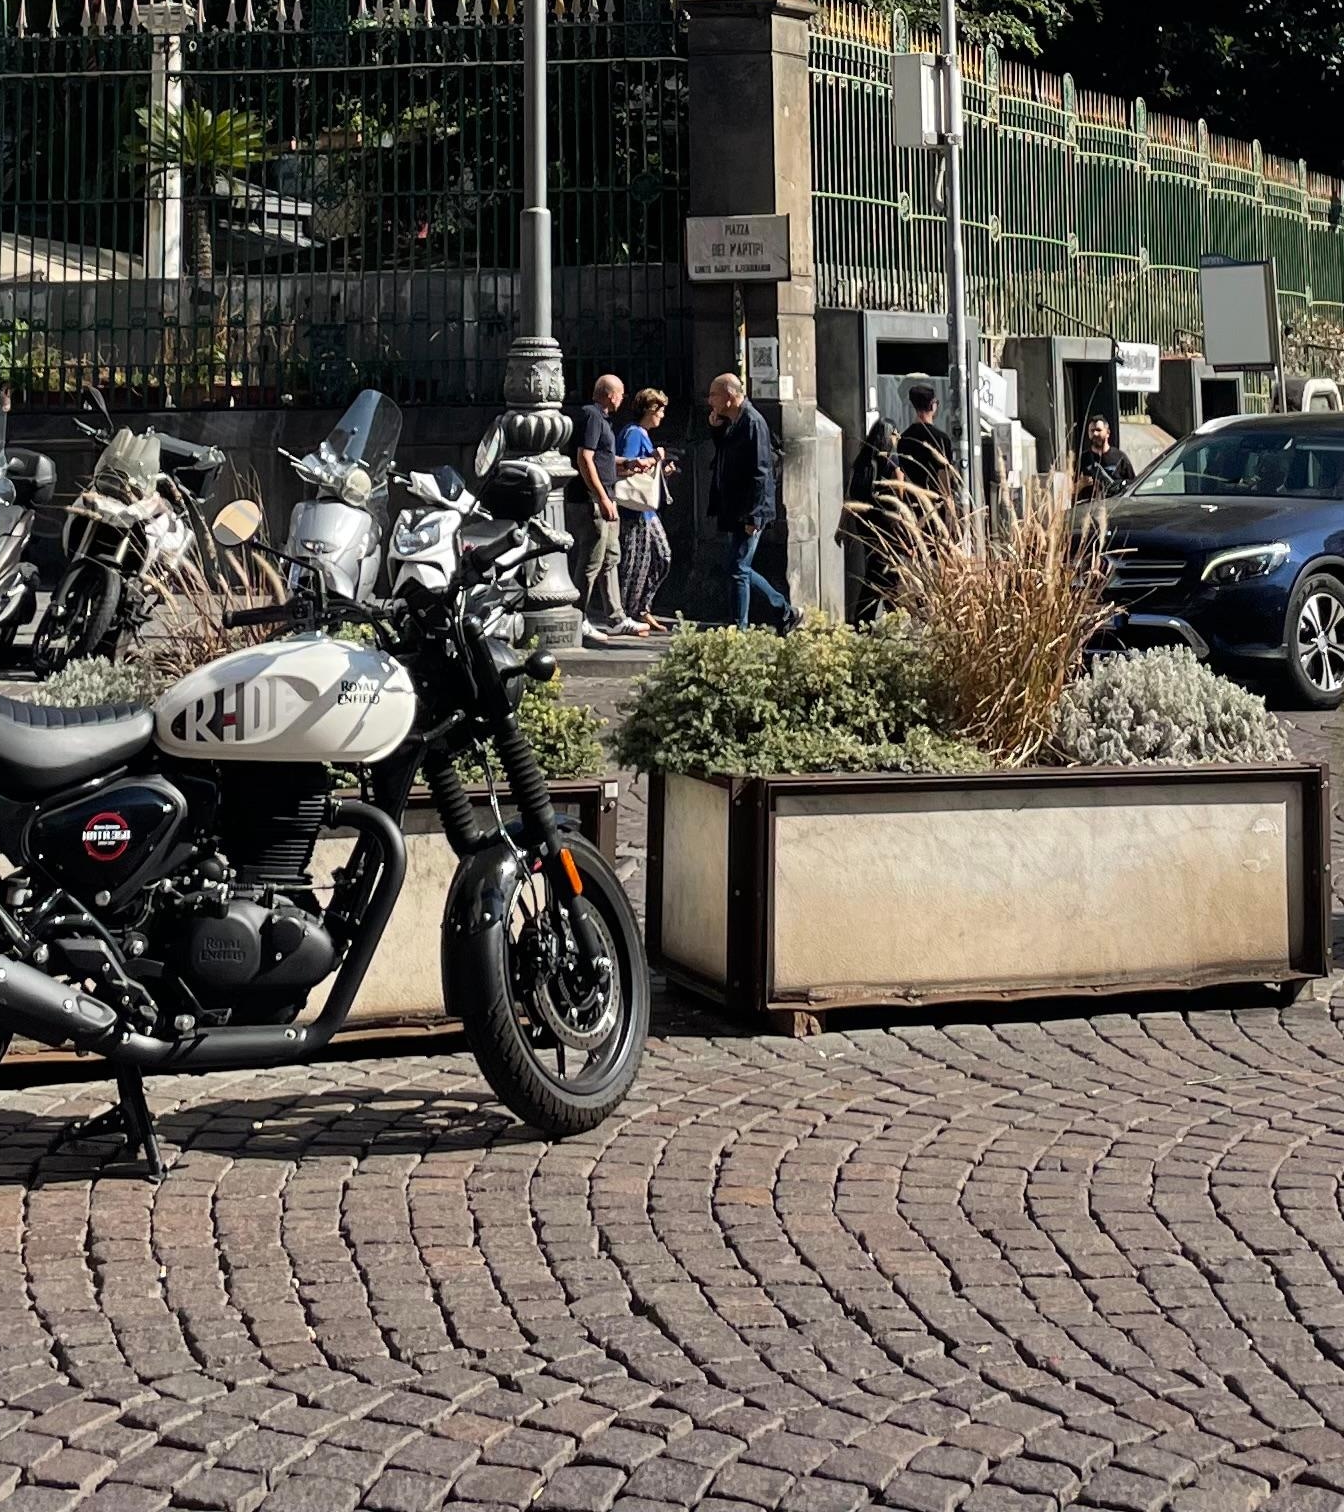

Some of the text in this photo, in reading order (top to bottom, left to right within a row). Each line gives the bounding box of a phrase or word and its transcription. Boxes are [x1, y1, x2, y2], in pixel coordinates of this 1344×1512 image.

[724, 223, 750, 236] PIAZZA
[341, 680, 375, 692] ROYAL
[338, 693, 380, 705] ENFIELD
